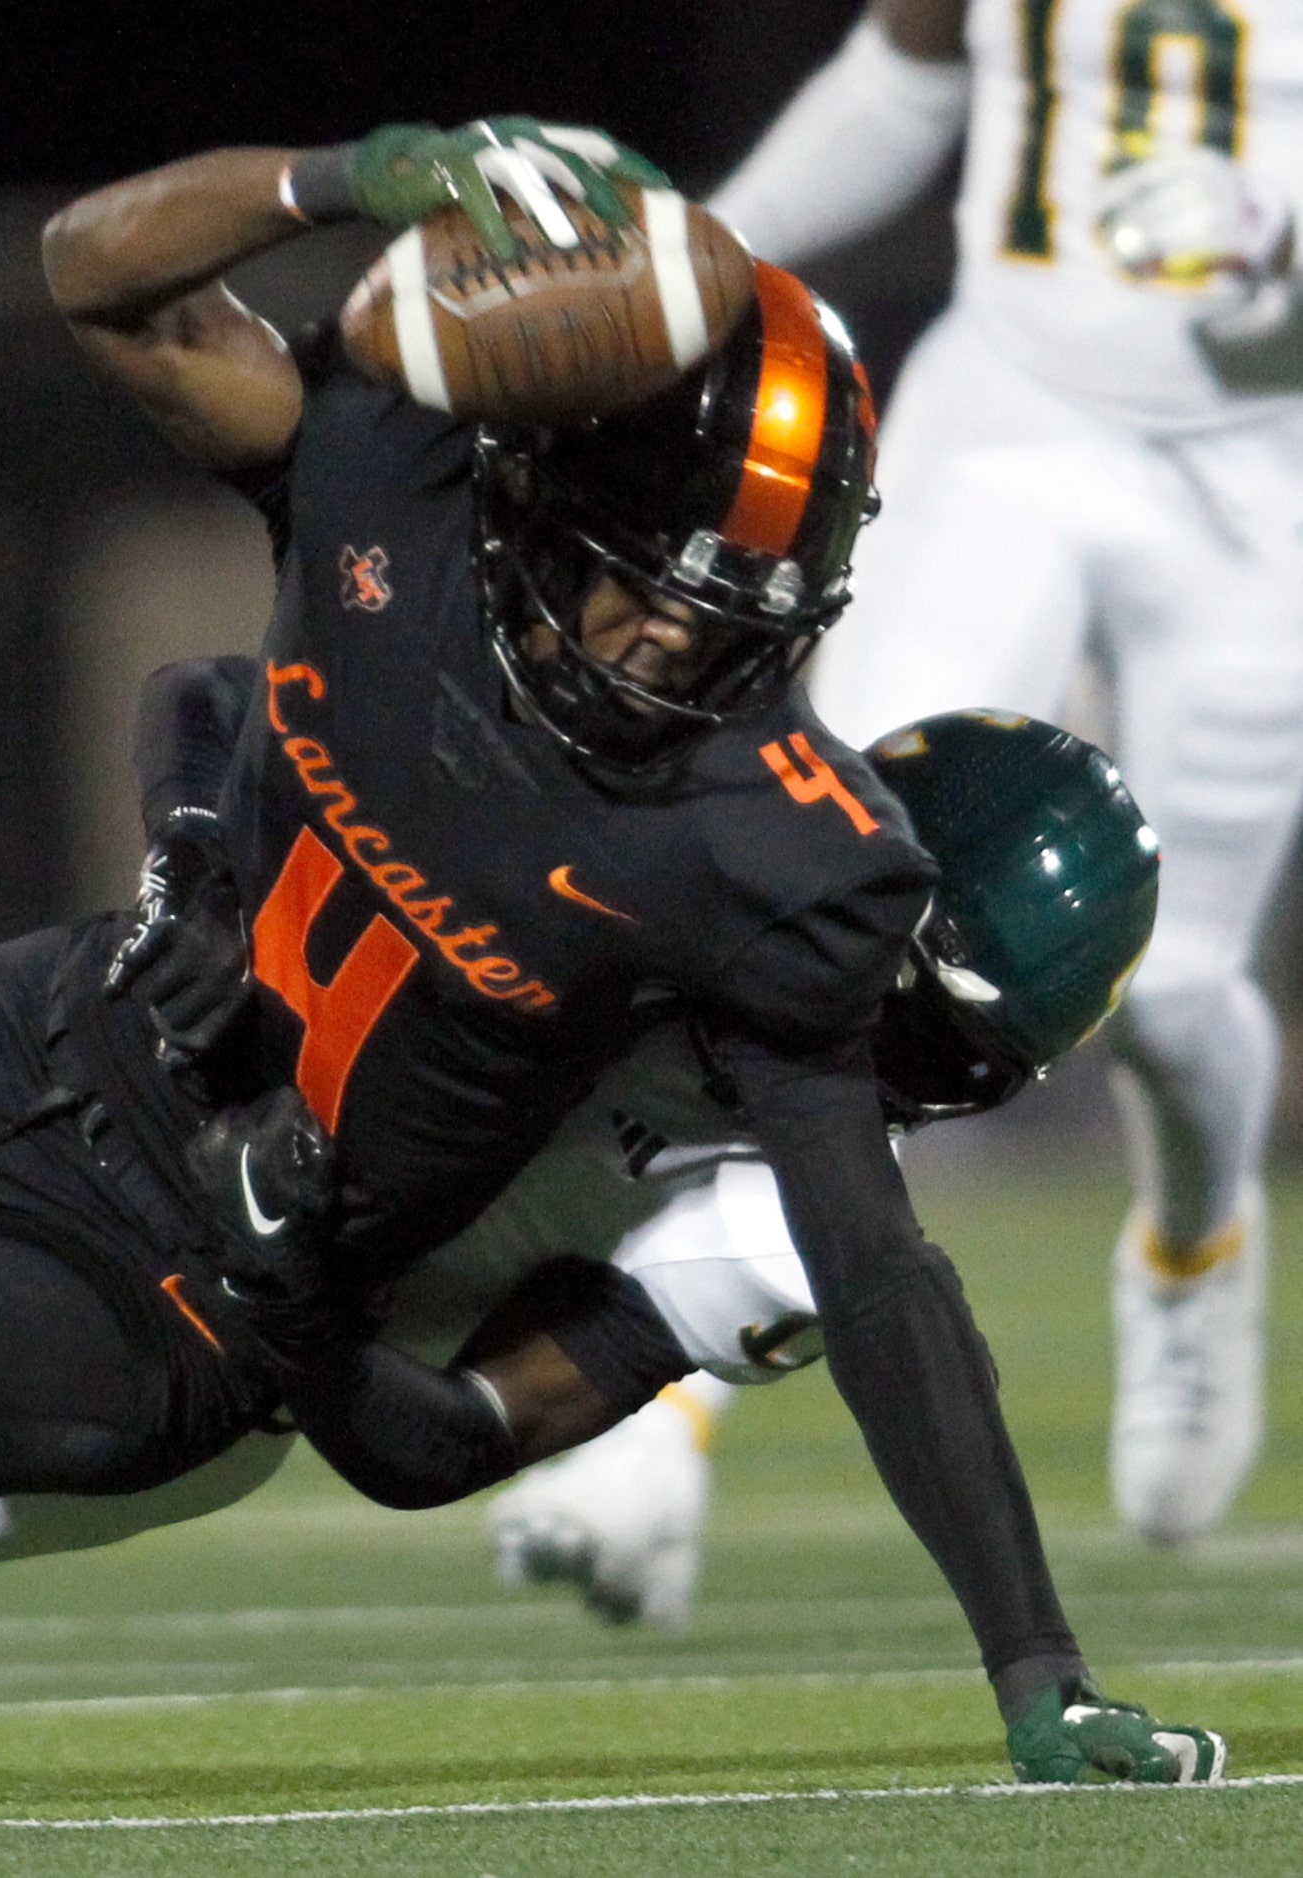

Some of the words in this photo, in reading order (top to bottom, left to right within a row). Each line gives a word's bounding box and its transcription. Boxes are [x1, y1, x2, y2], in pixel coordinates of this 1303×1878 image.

[266, 660, 555, 1008] Lancaster
[758, 731, 880, 835] 4
[252, 825, 420, 1136] 4
